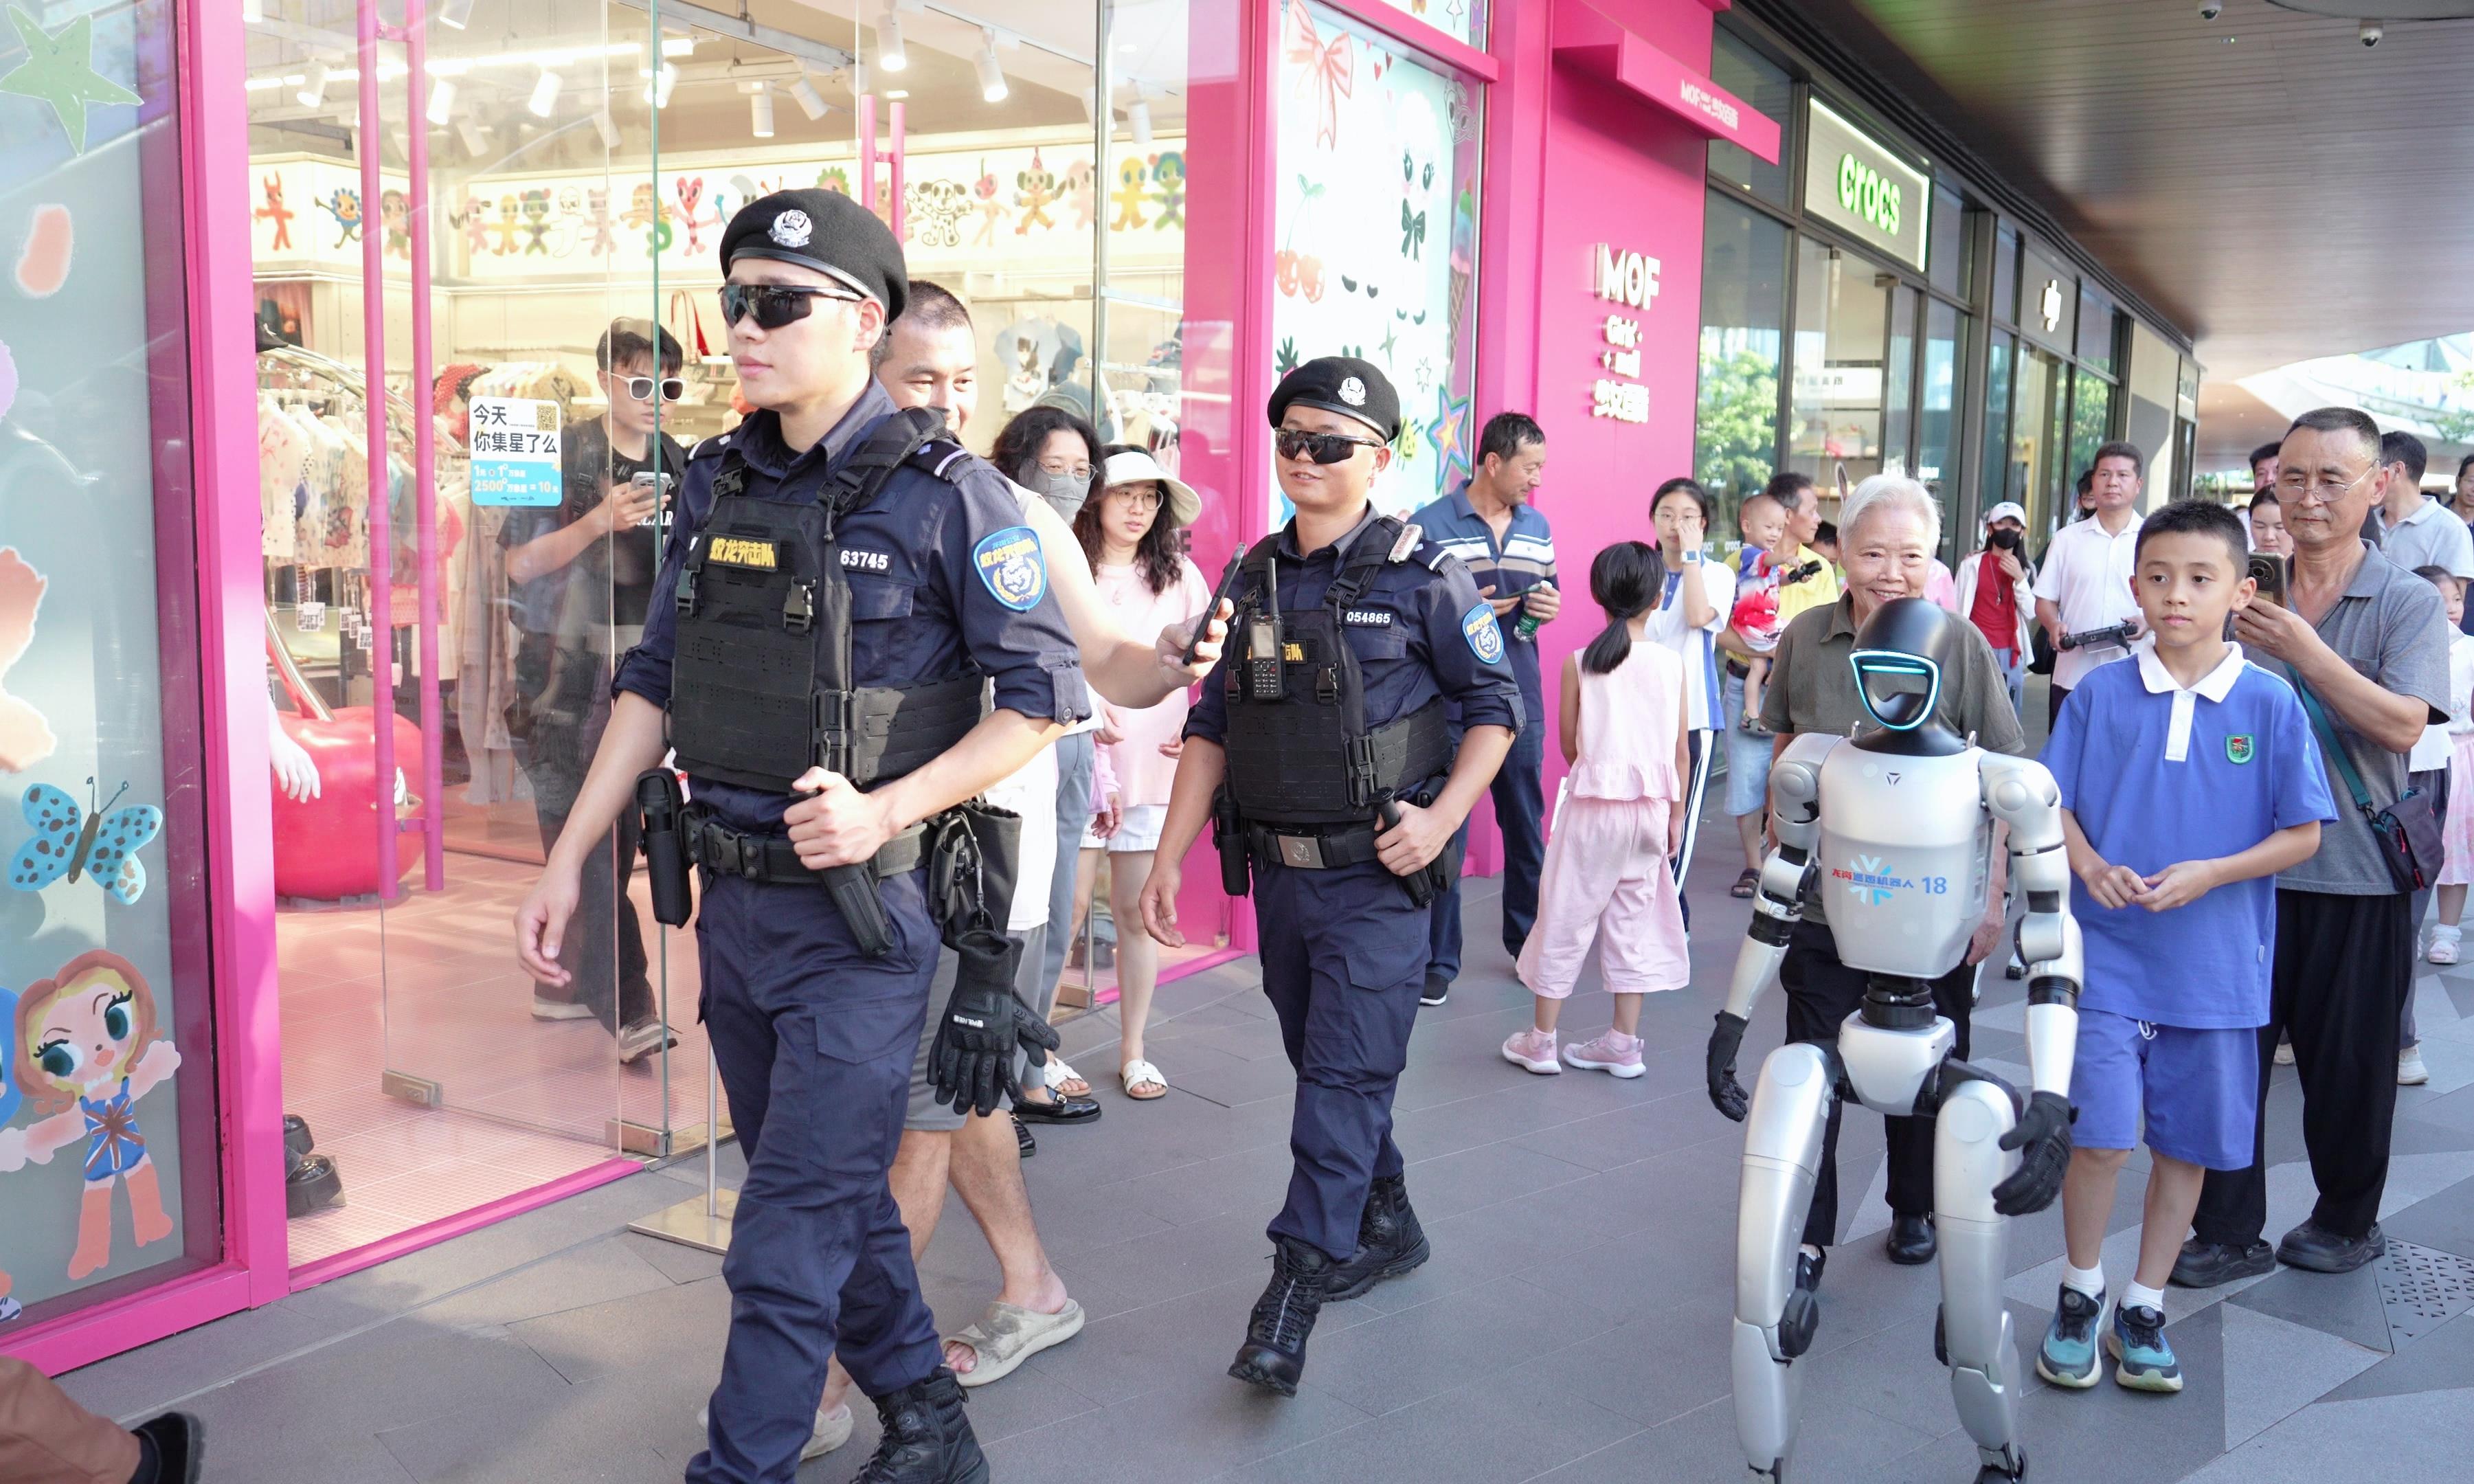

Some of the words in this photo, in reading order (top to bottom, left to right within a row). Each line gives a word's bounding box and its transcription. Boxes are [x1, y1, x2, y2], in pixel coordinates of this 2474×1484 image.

[1838, 153, 1900, 235] crocs
[1595, 243, 1661, 311] MOF
[473, 403, 507, 426] 今天
[473, 430, 558, 453] 你集星了么
[708, 537, 776, 568] 蛟龙突击队
[840, 549, 888, 570] 63745
[1346, 611, 1391, 624] 054865
[1921, 876, 1947, 894] 18
